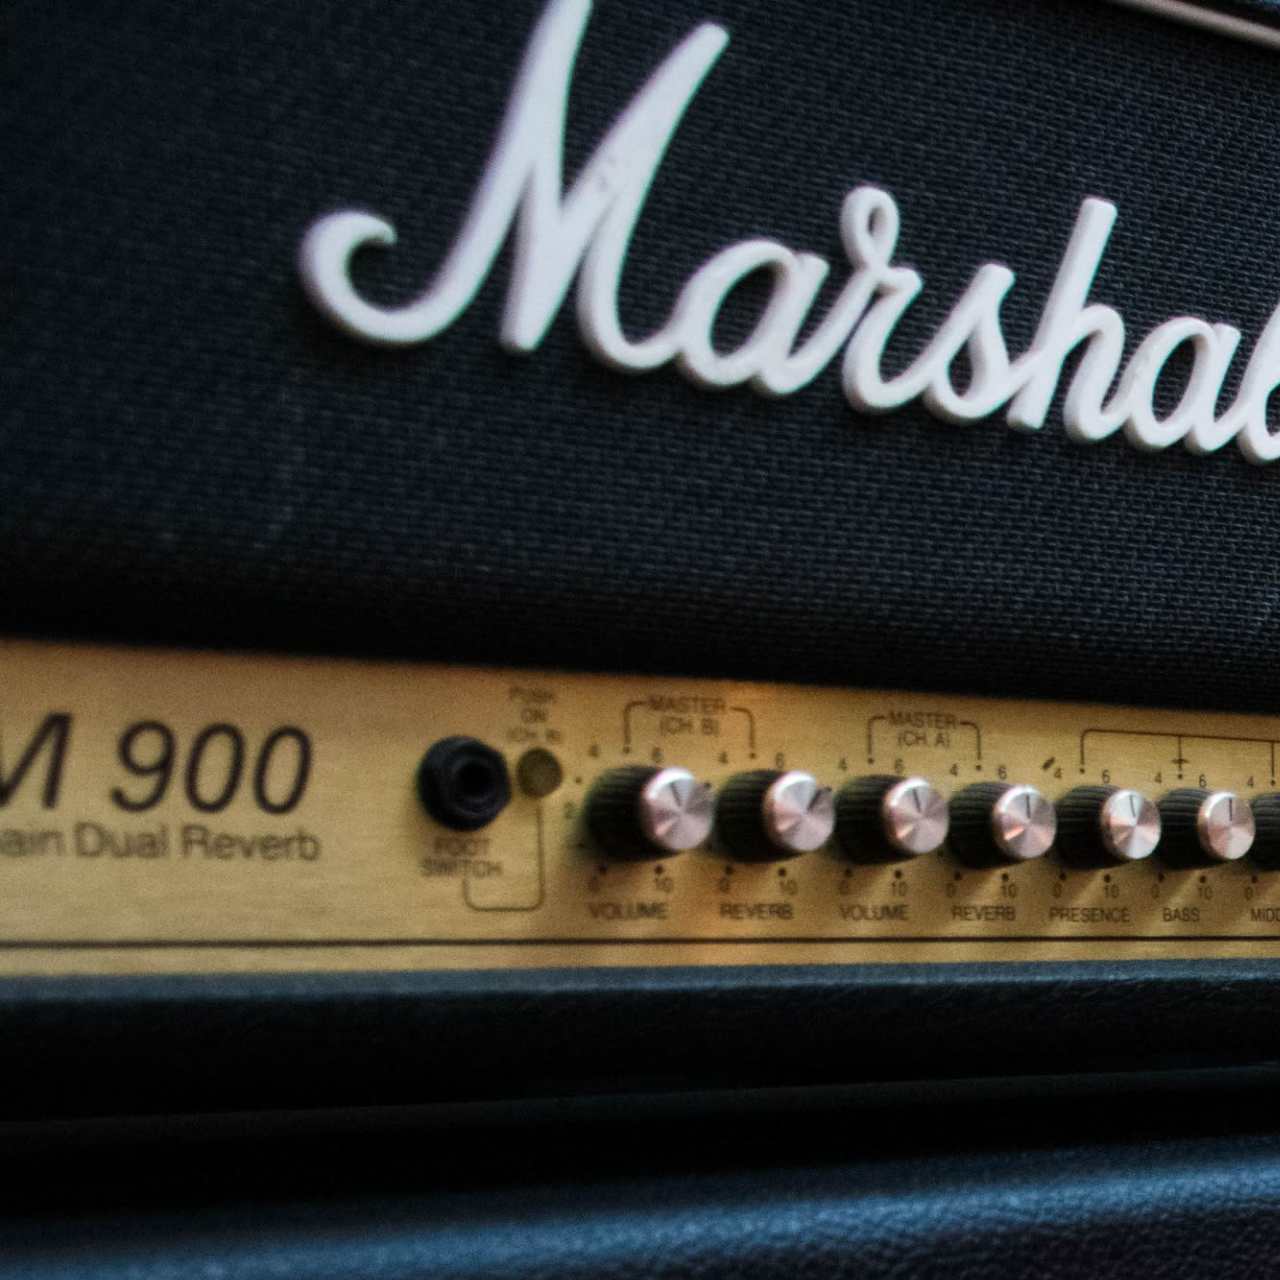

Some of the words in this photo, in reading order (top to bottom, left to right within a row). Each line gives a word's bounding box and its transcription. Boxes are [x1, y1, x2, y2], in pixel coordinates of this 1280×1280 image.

[648, 695, 727, 714] MASTER
[889, 711, 957, 729] MASTER
[111, 720, 312, 814] 900
[1053, 768, 1062, 780] 4
[1102, 770, 1111, 784] 6
[1154, 772, 1162, 784] 4
[1199, 774, 1207, 788] 6
[74, 821, 169, 859] Dual
[181, 823, 321, 861] Reverb
[588, 902, 669, 920] VOLUME
[719, 903, 795, 920] REVERB
[839, 904, 909, 921] VOLUME
[952, 905, 1017, 921] REVERB
[1049, 907, 1131, 923] PRESENCE
[1162, 908, 1201, 922] BASS
